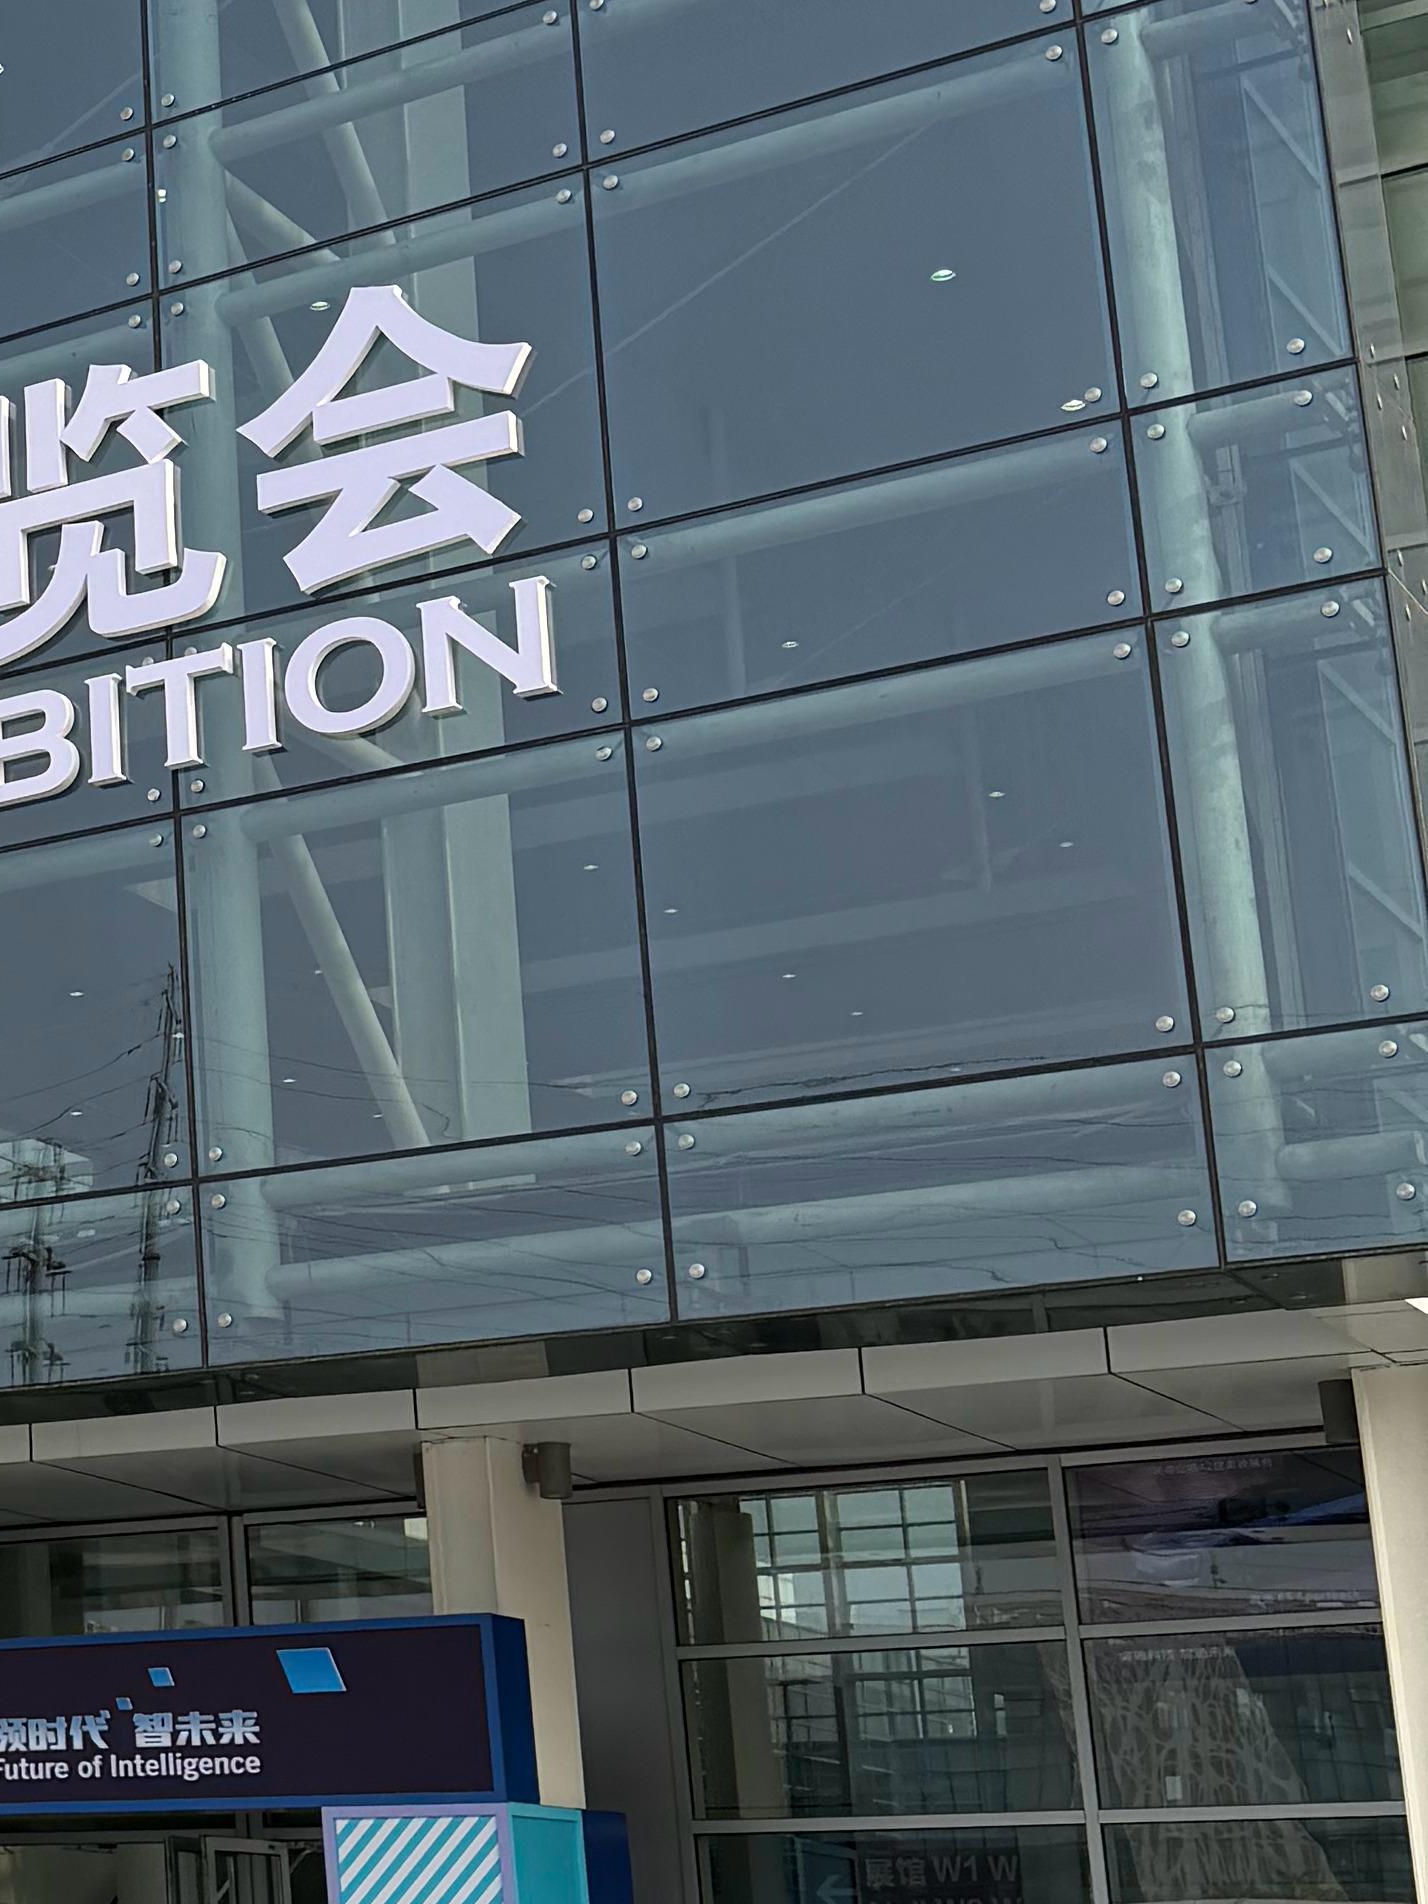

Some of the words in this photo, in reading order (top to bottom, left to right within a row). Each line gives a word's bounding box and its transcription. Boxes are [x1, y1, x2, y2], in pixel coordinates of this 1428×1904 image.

[133, 1710, 261, 1748] 智未来
[78, 1755, 104, 1779] of
[110, 1752, 261, 1781] Intelligence
